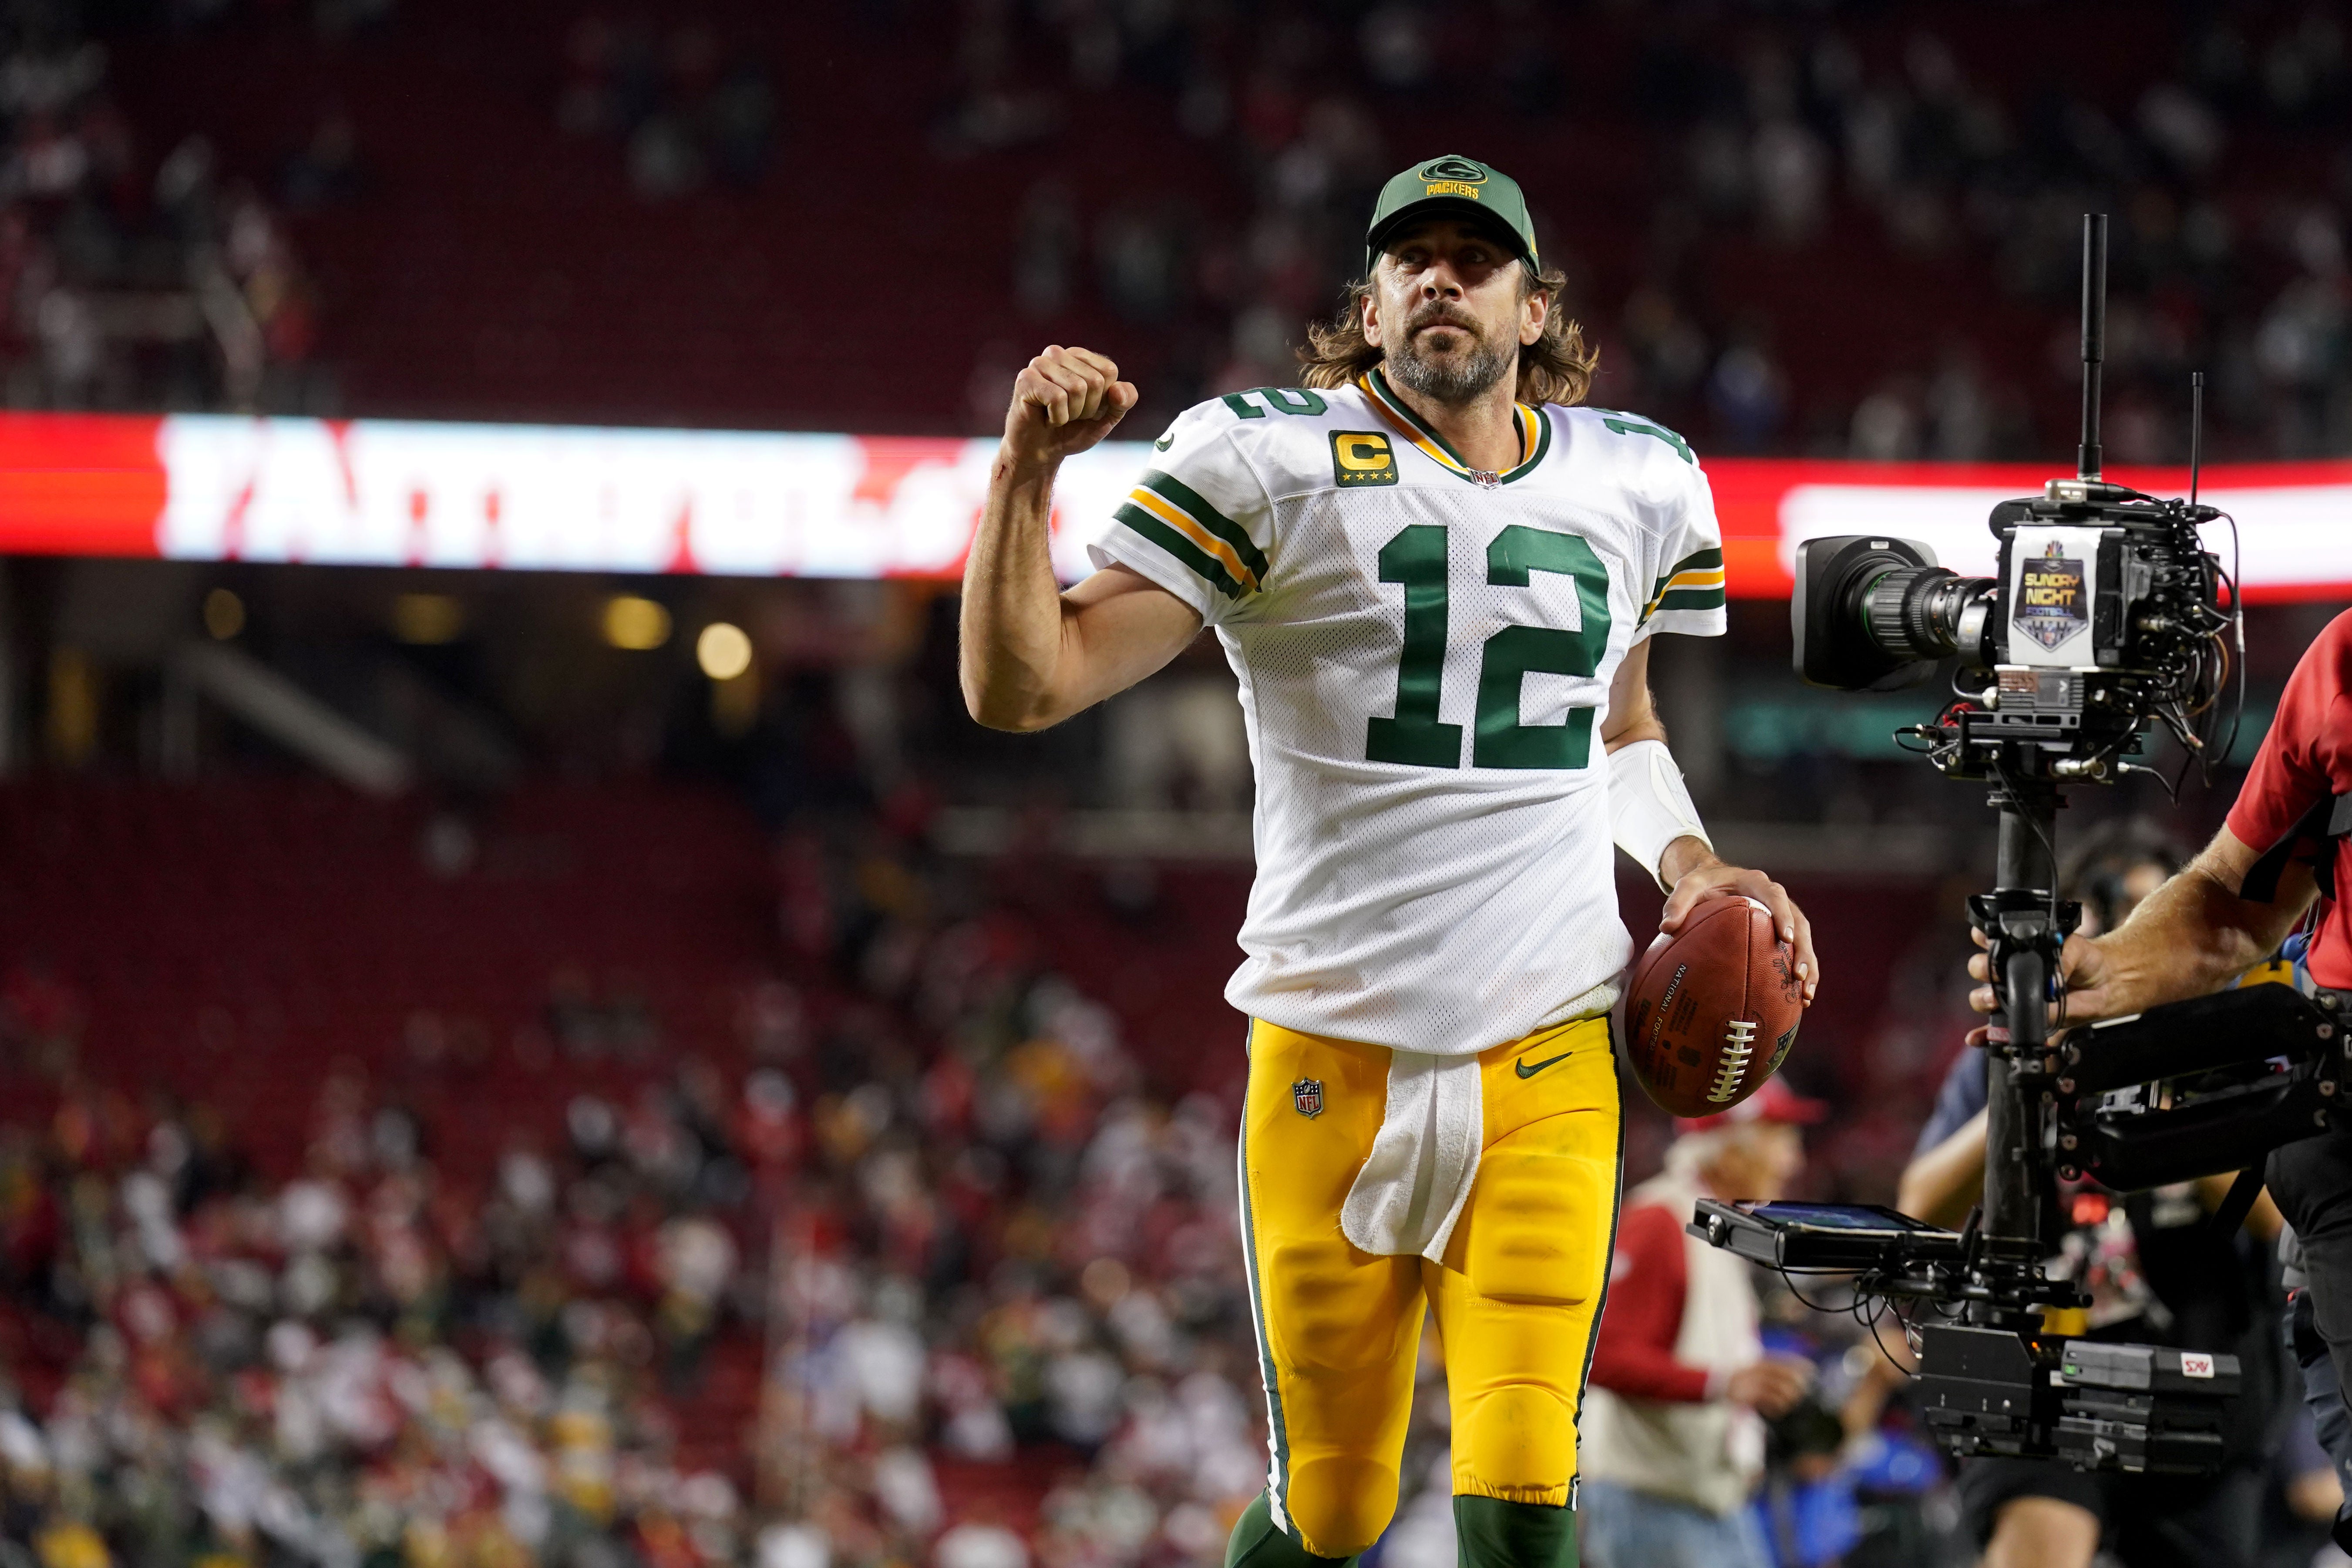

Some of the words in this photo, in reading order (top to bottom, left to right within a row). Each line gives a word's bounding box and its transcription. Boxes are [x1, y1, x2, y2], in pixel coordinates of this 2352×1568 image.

[1427, 182, 1479, 199] PACKERS
[1335, 434, 1391, 471] C
[1475, 474, 1497, 484] NFL
[2025, 572, 2080, 587] SUNDAY
[2026, 588, 2076, 605] NIGHT
[1366, 524, 1612, 770] 12
[1660, 963, 1687, 1013] NATIONAL
[1646, 1016, 1663, 1061] FOOTBA
[1298, 1096, 1319, 1111] NFL
